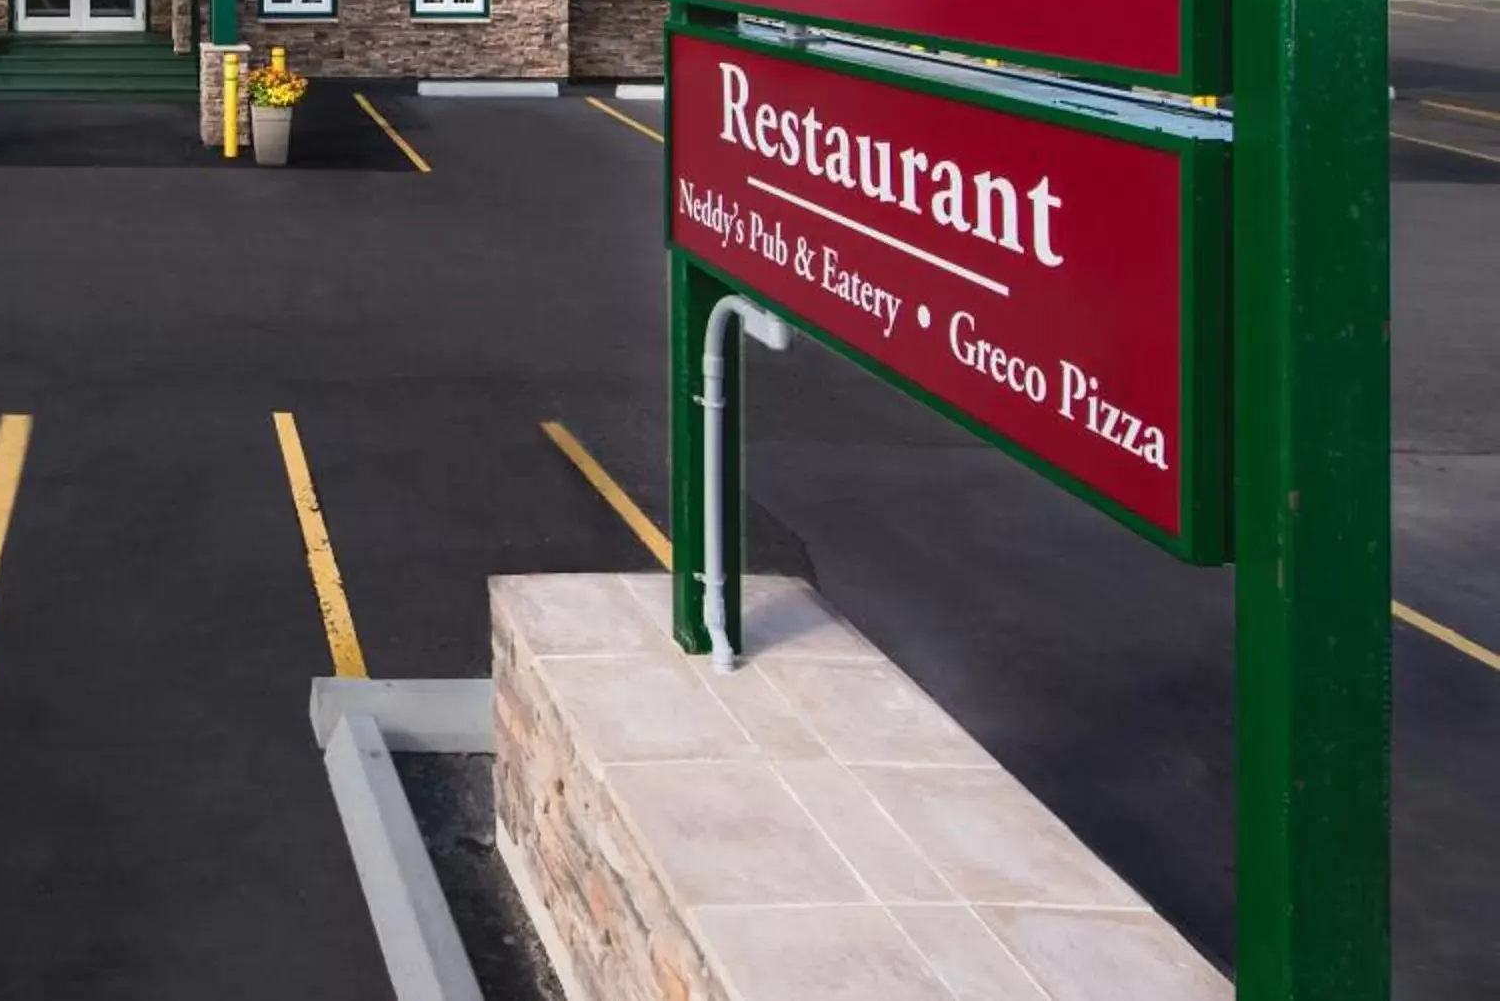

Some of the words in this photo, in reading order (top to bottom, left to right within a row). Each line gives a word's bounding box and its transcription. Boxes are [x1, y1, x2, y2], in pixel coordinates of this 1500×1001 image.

[719, 62, 1064, 267] Restaurant
[679, 178, 745, 249] Neddy's
[749, 211, 789, 267] Pub
[794, 236, 816, 283] &
[821, 246, 902, 338] Eatery
[949, 311, 1047, 403] Greco
[1059, 360, 1169, 470] Pizza
